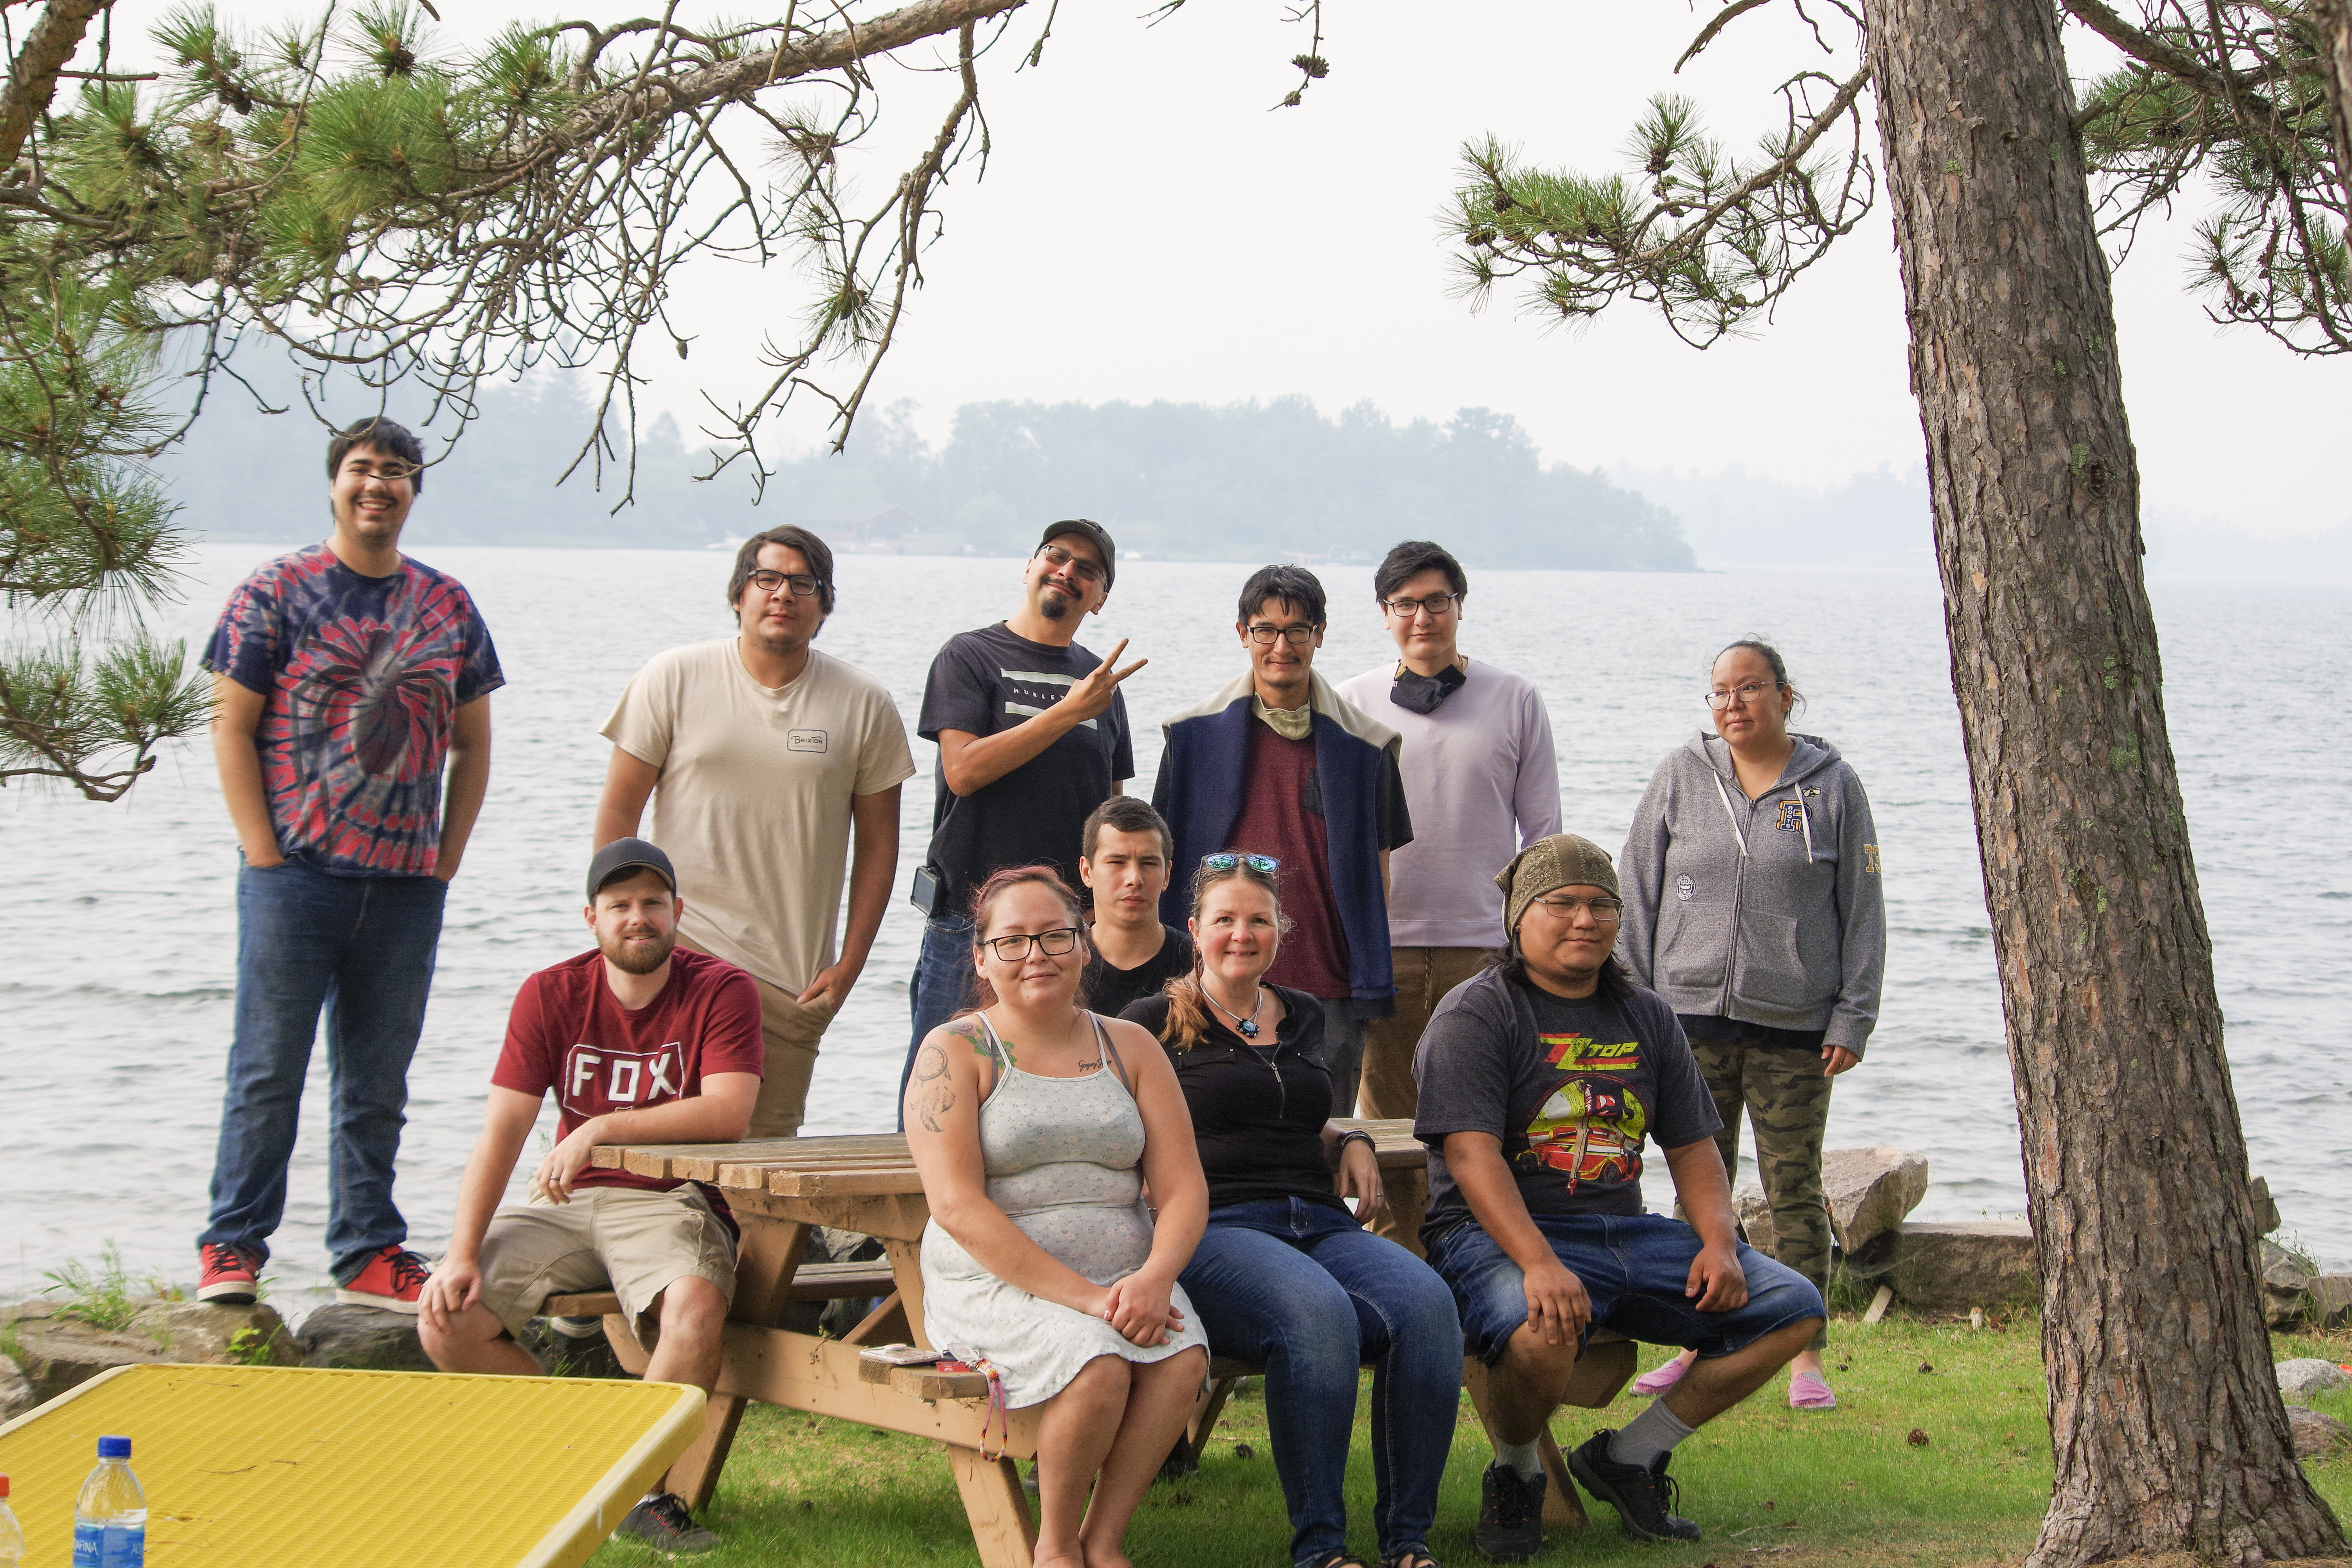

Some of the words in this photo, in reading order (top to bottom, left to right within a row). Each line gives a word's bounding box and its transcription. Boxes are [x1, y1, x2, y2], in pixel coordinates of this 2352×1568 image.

[1013, 688, 1065, 700] HURLEY
[791, 736, 822, 744] BRIXTON
[1587, 1042, 1639, 1057] TOP
[571, 1052, 677, 1102] FOX
